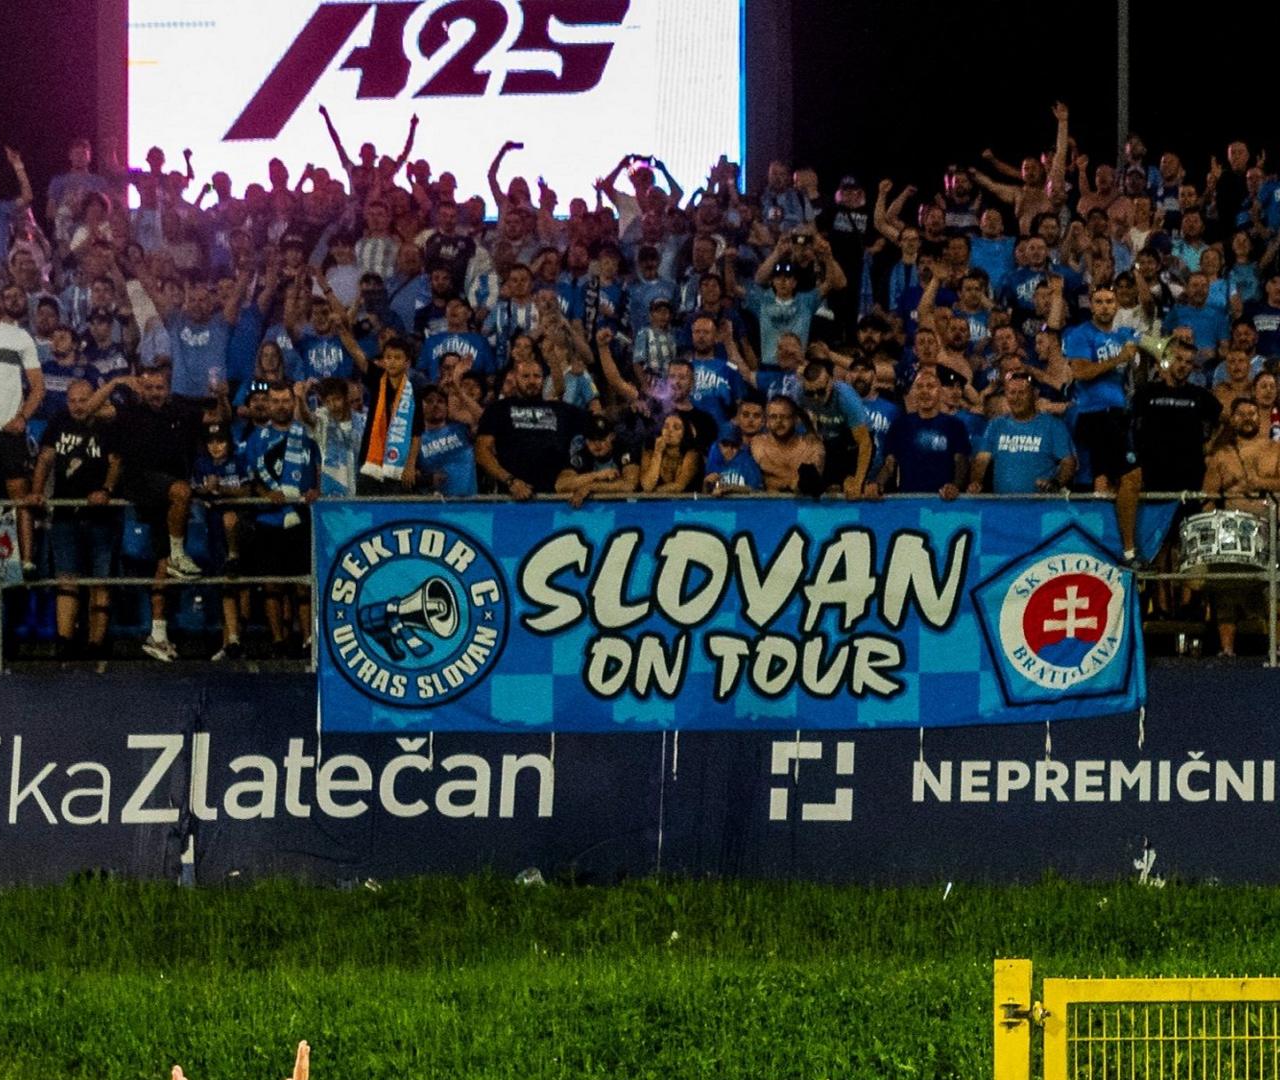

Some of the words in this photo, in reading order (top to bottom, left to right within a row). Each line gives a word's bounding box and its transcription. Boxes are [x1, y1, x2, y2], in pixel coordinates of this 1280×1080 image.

[331, 527, 477, 605] SEKTOR
[471, 579, 500, 608] C
[521, 530, 968, 632] SLOVAN
[332, 623, 406, 699] ULTRAS
[417, 624, 499, 699] SLOVAN
[587, 634, 687, 698] ON
[708, 635, 901, 699] TOUR
